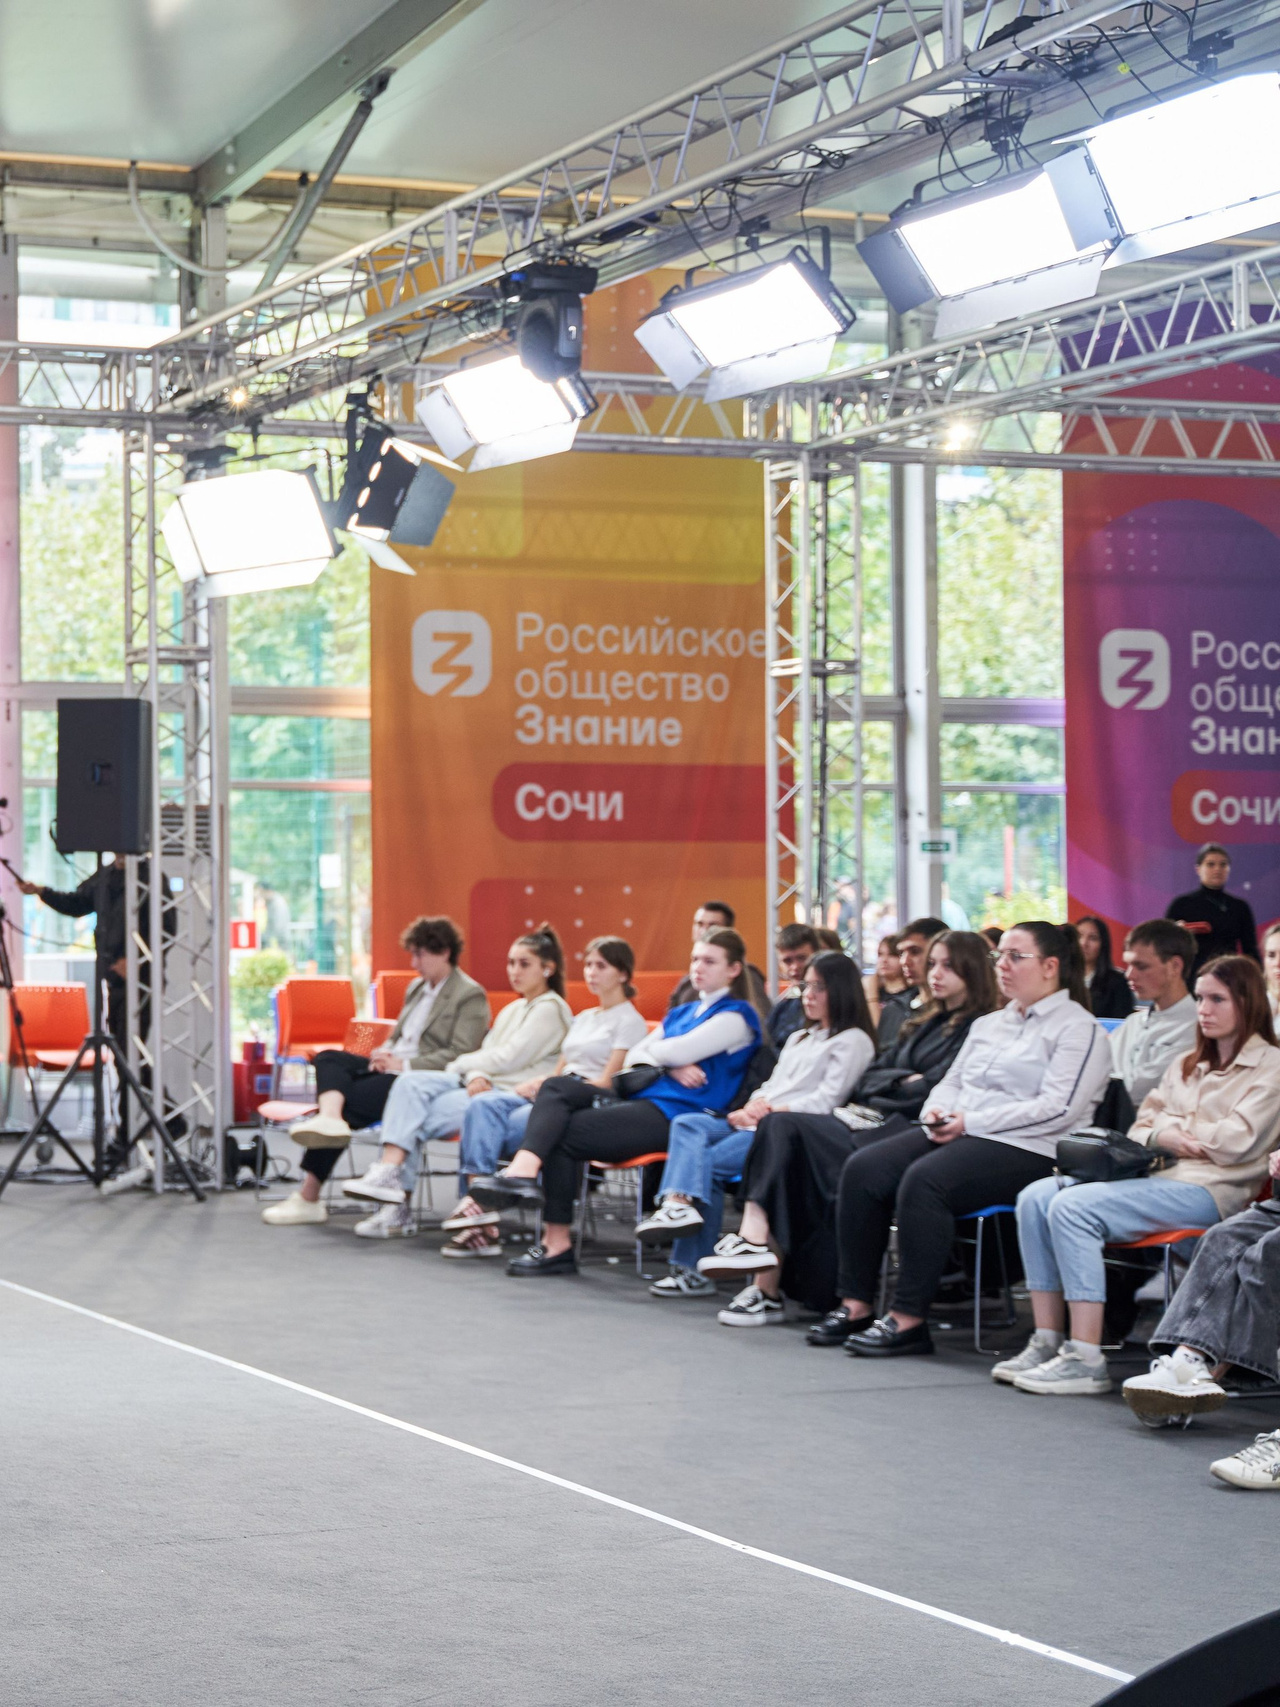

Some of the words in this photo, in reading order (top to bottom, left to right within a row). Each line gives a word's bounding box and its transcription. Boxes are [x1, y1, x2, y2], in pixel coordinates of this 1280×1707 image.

[516, 612, 766, 658] Российское
[515, 660, 729, 706] общество
[1191, 674, 1280, 718] общ
[516, 704, 682, 747] Знание
[515, 783, 624, 821] Сочи
